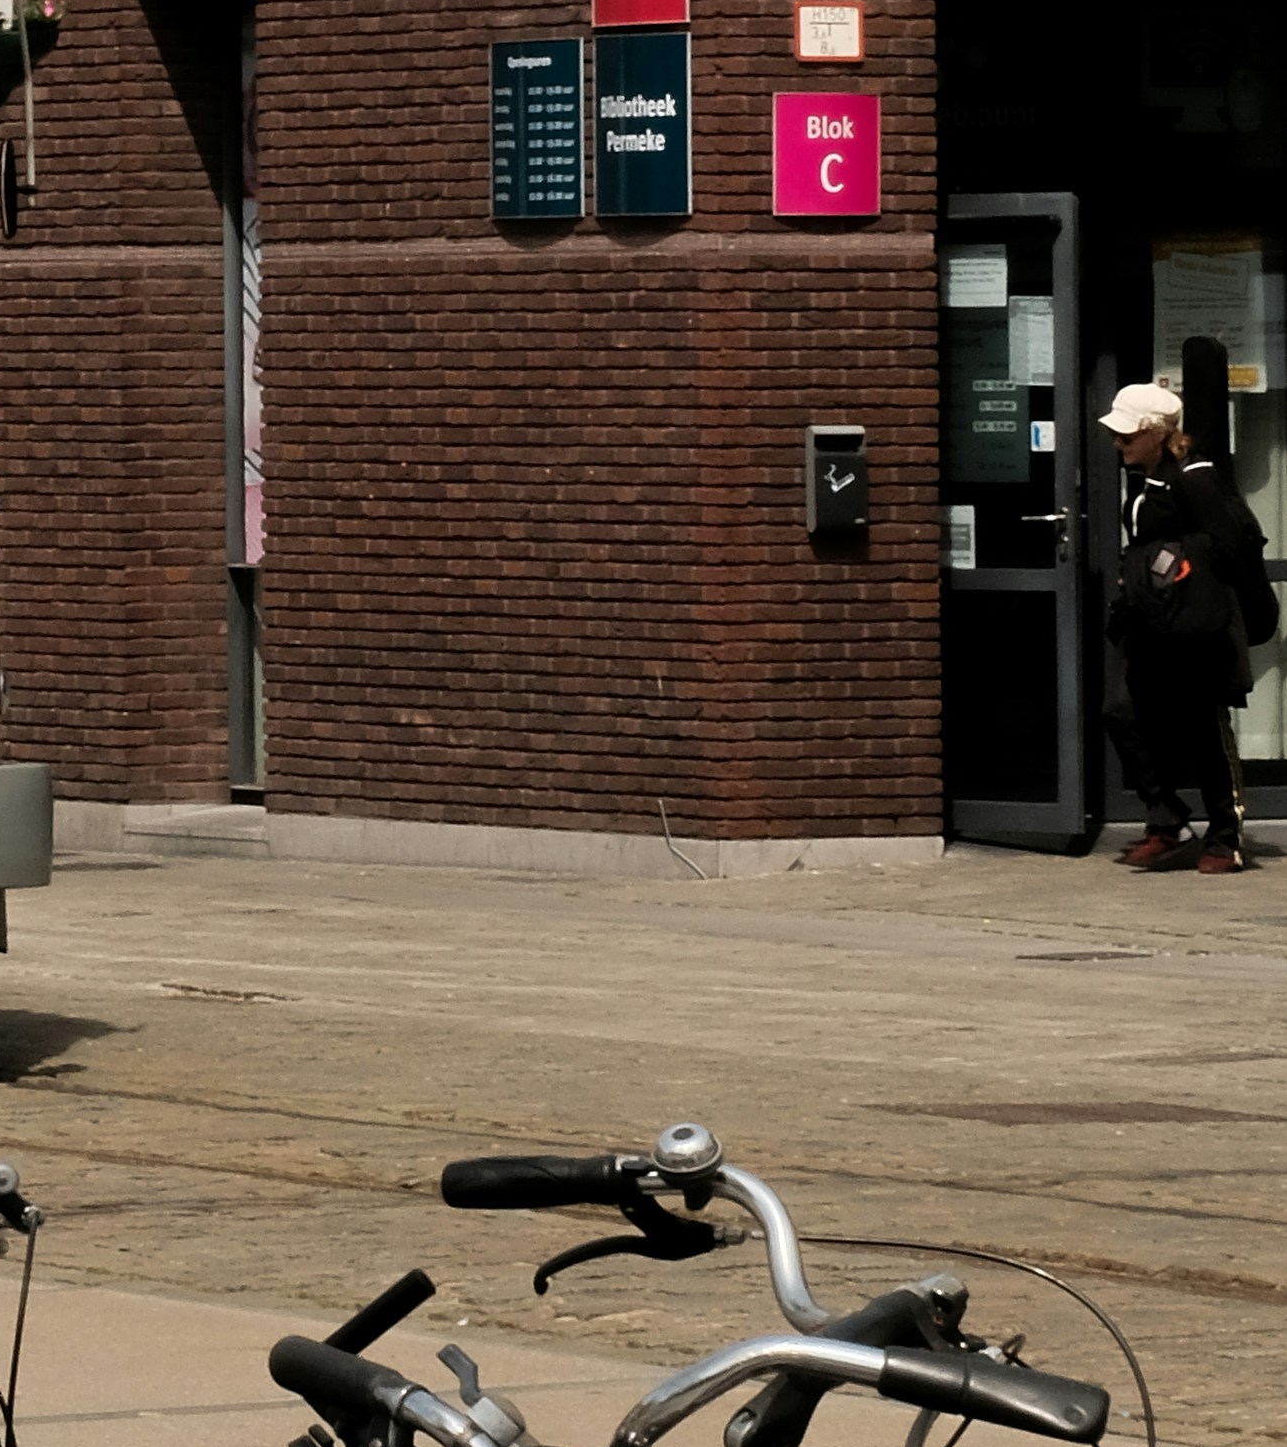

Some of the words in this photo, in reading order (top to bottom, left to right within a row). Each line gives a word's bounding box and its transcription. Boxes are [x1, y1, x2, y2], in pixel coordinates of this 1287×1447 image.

[600, 93, 677, 119] Bibliotheek
[806, 115, 854, 139] Blok
[606, 128, 666, 153] Permeke
[820, 153, 844, 193] C
